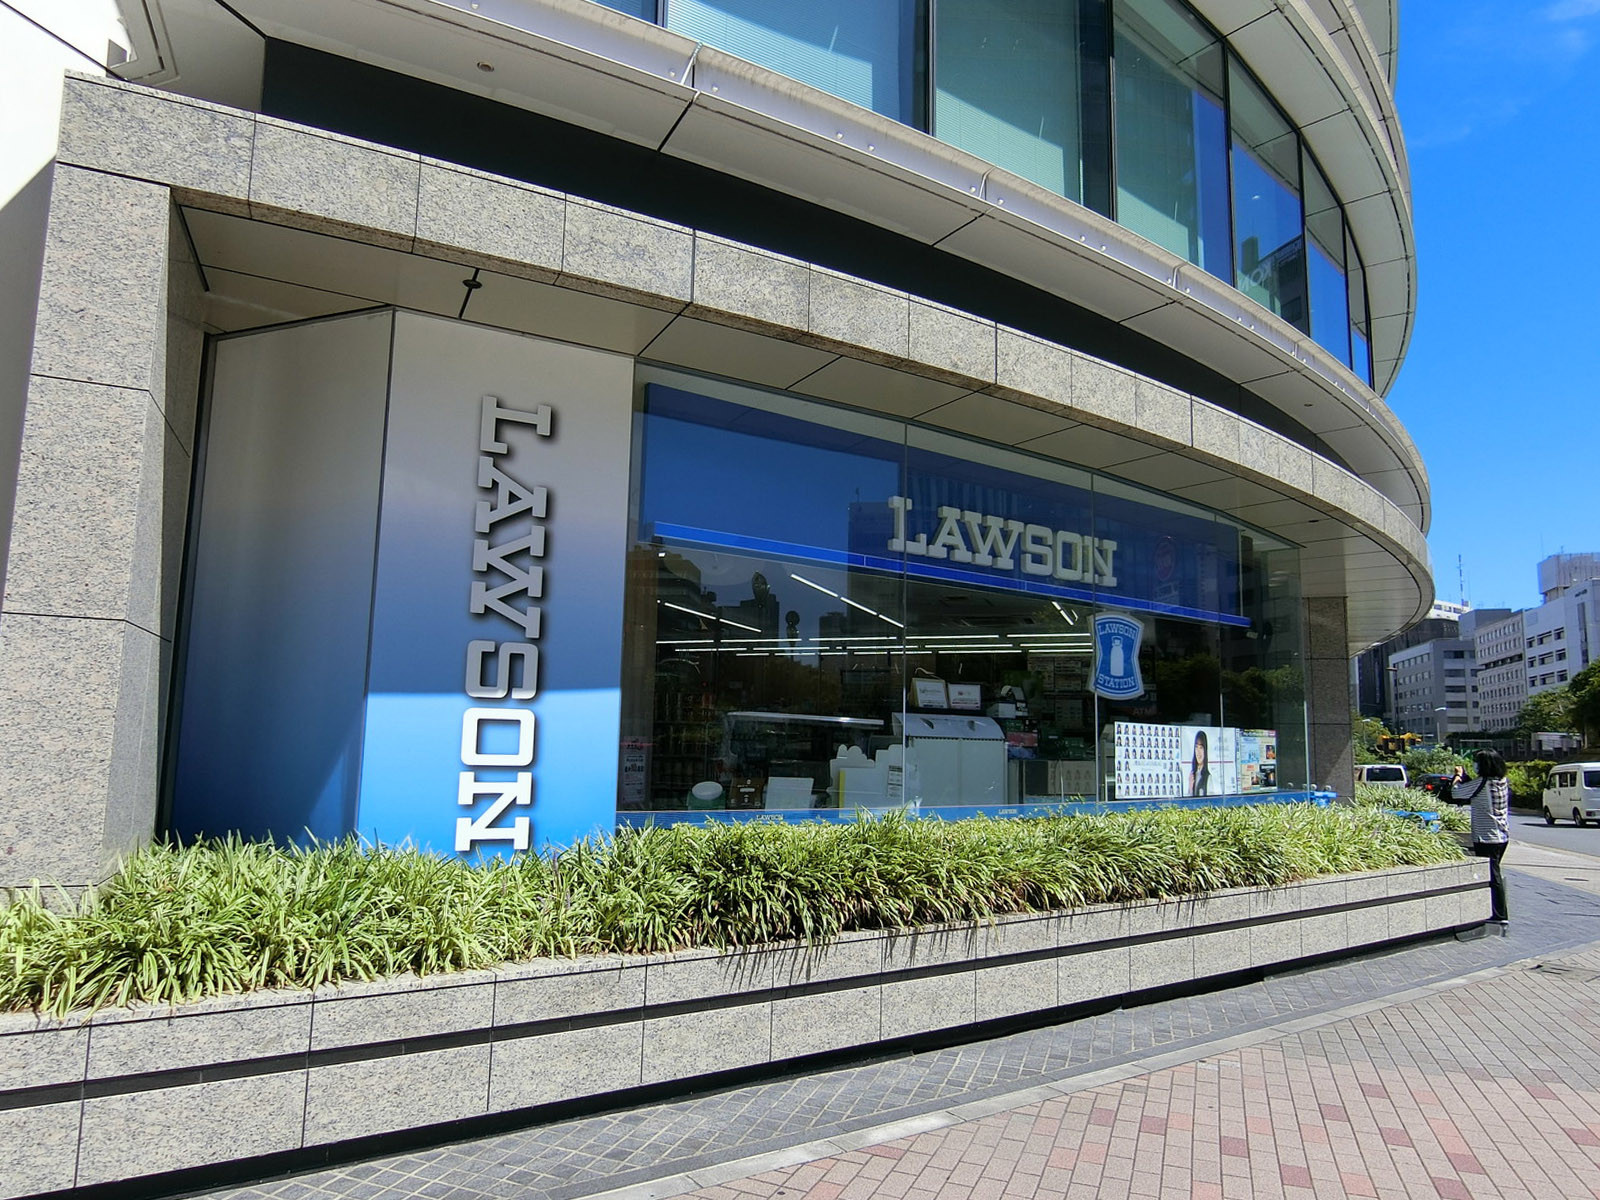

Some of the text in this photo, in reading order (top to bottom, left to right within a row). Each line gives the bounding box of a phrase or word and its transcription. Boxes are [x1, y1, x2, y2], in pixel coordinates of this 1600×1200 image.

[887, 495, 1118, 588] LAWSON
[455, 395, 552, 851] LAWSON
[1098, 623, 1137, 640] LAWSON
[1097, 673, 1135, 689] STATION
